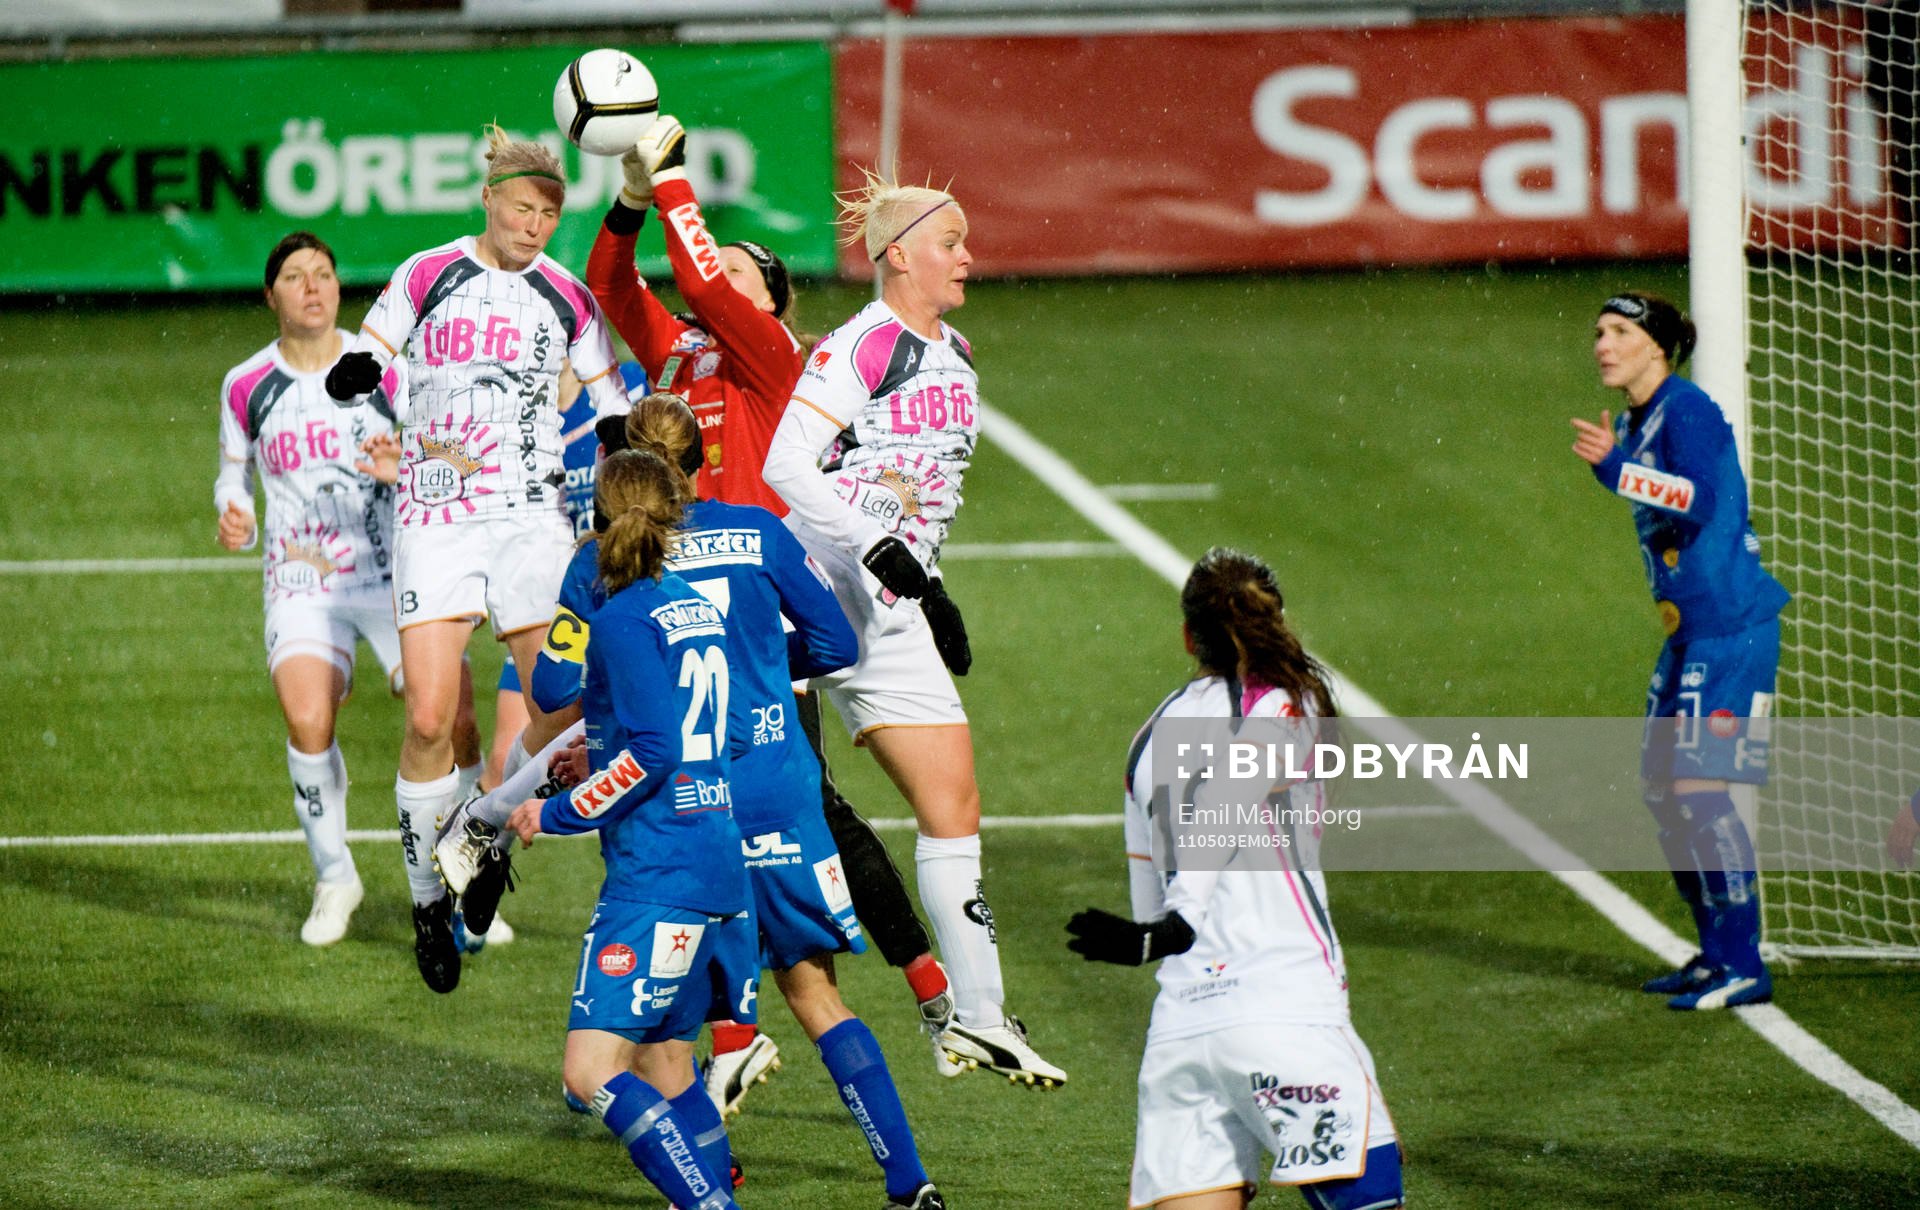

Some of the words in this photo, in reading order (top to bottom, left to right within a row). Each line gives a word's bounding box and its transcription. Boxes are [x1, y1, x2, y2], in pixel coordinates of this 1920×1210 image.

[677, 204, 720, 278] MAXI
[424, 317, 476, 366] LdB
[890, 386, 948, 434] LdB
[420, 468, 454, 487] LdB
[1620, 473, 1691, 510] MAXI
[861, 490, 899, 519] LdB
[400, 590, 419, 616] 13
[547, 613, 581, 651] C
[771, 730, 785, 743] AB
[574, 756, 646, 816] MAXI
[655, 1116, 711, 1198] CENTRIC.se
